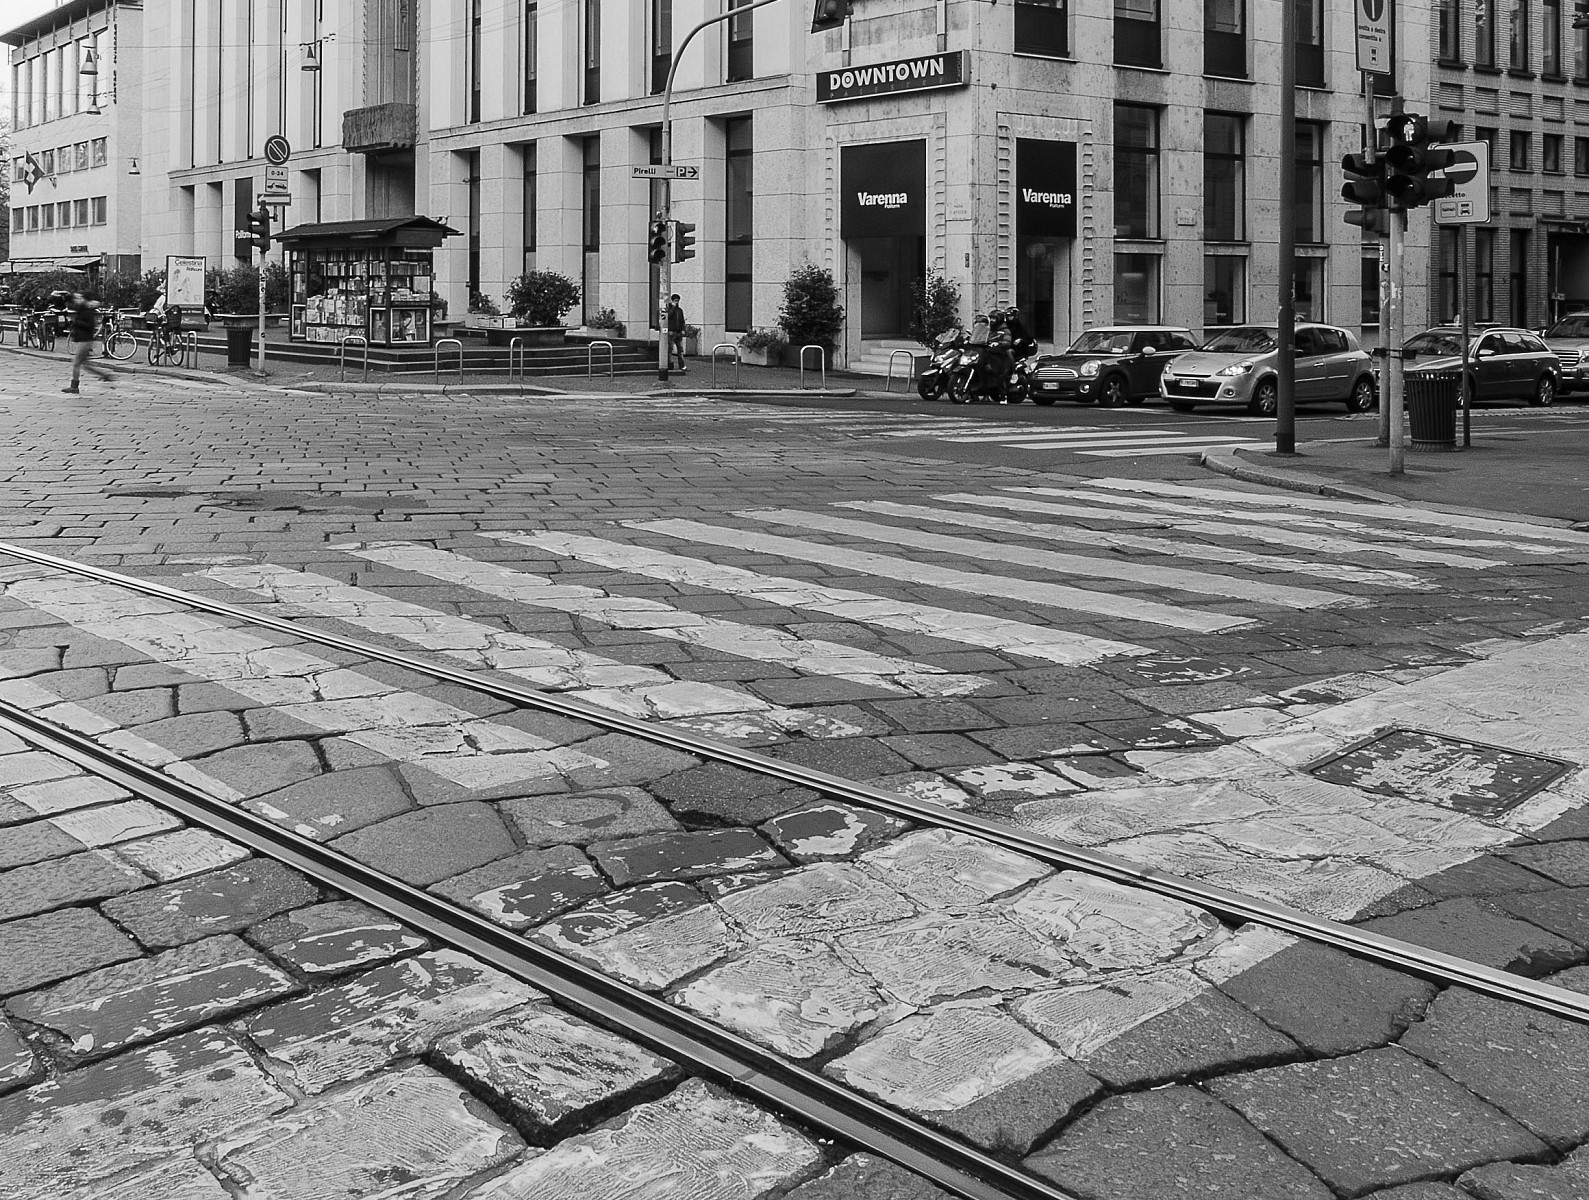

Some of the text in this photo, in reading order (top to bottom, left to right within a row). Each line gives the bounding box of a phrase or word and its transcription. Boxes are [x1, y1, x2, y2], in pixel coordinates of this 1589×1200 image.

[829, 57, 944, 91] DOWNTOWN
[633, 167, 656, 175] Pirelli
[857, 191, 908, 206] Varenna
[1022, 188, 1072, 204] Varenna
